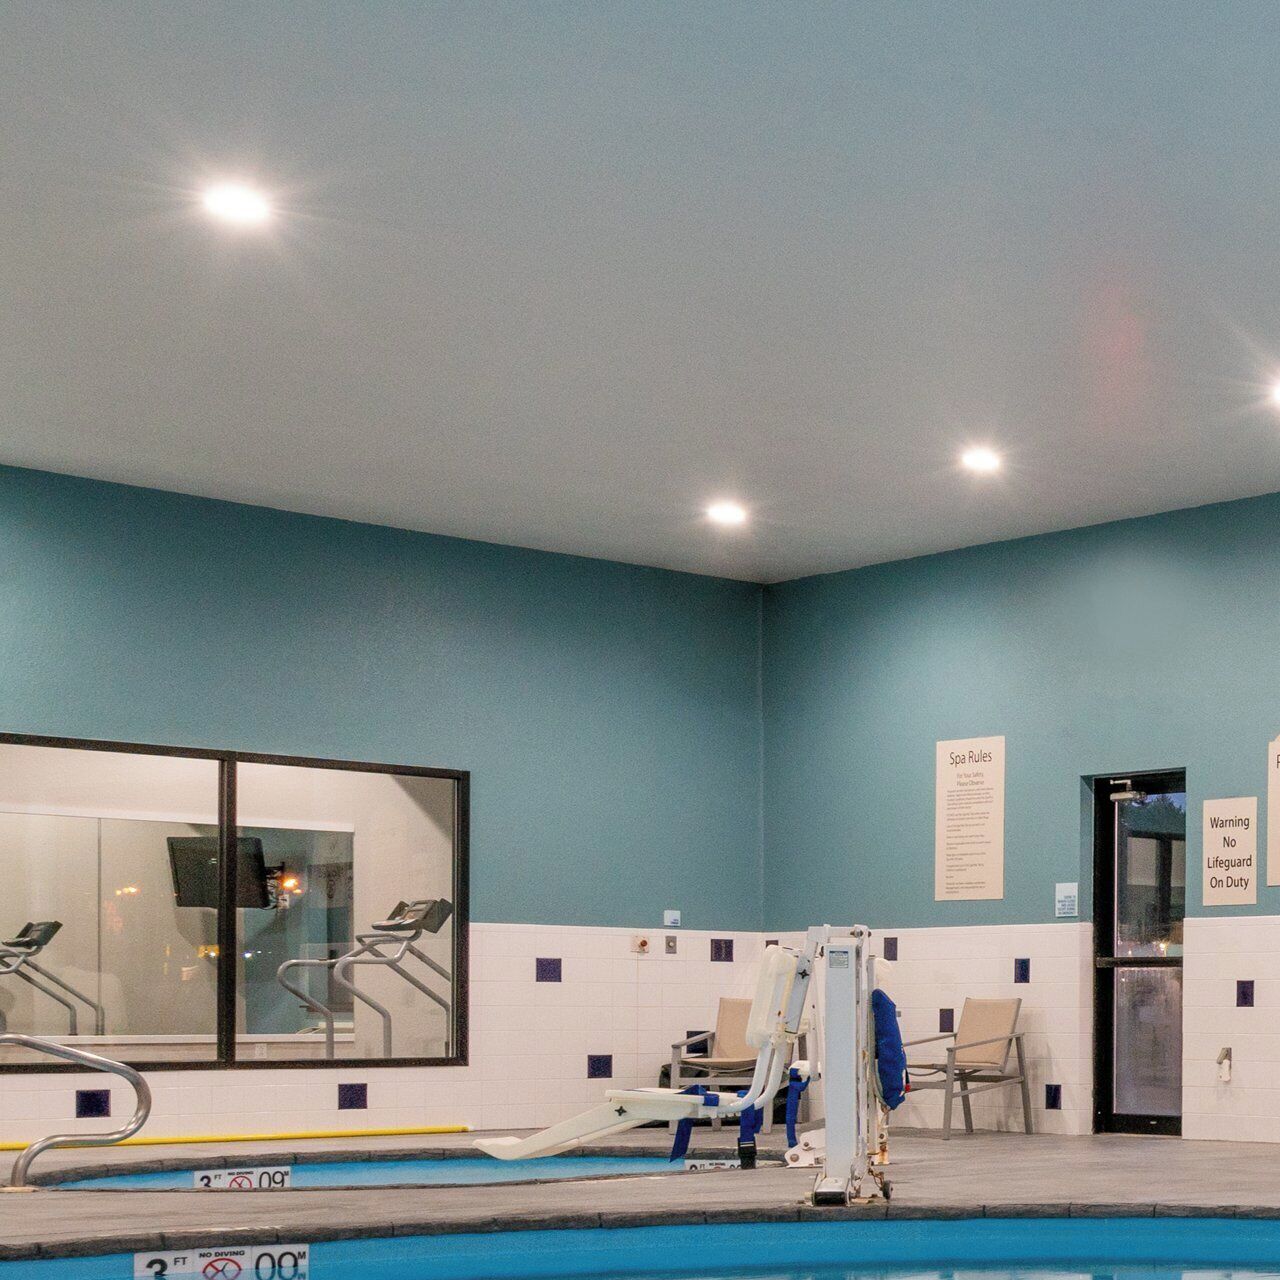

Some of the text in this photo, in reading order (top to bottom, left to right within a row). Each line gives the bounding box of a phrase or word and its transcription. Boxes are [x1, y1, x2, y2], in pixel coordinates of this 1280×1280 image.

[949, 749, 993, 768] Spa Rules
[1209, 815, 1250, 830] Warning
[1222, 836, 1237, 848] No
[1207, 854, 1252, 871] Lifeguard
[1209, 875, 1250, 890] On Duty
[173, 1256, 188, 1266] FT
[214, 1250, 245, 1258] DIVING
